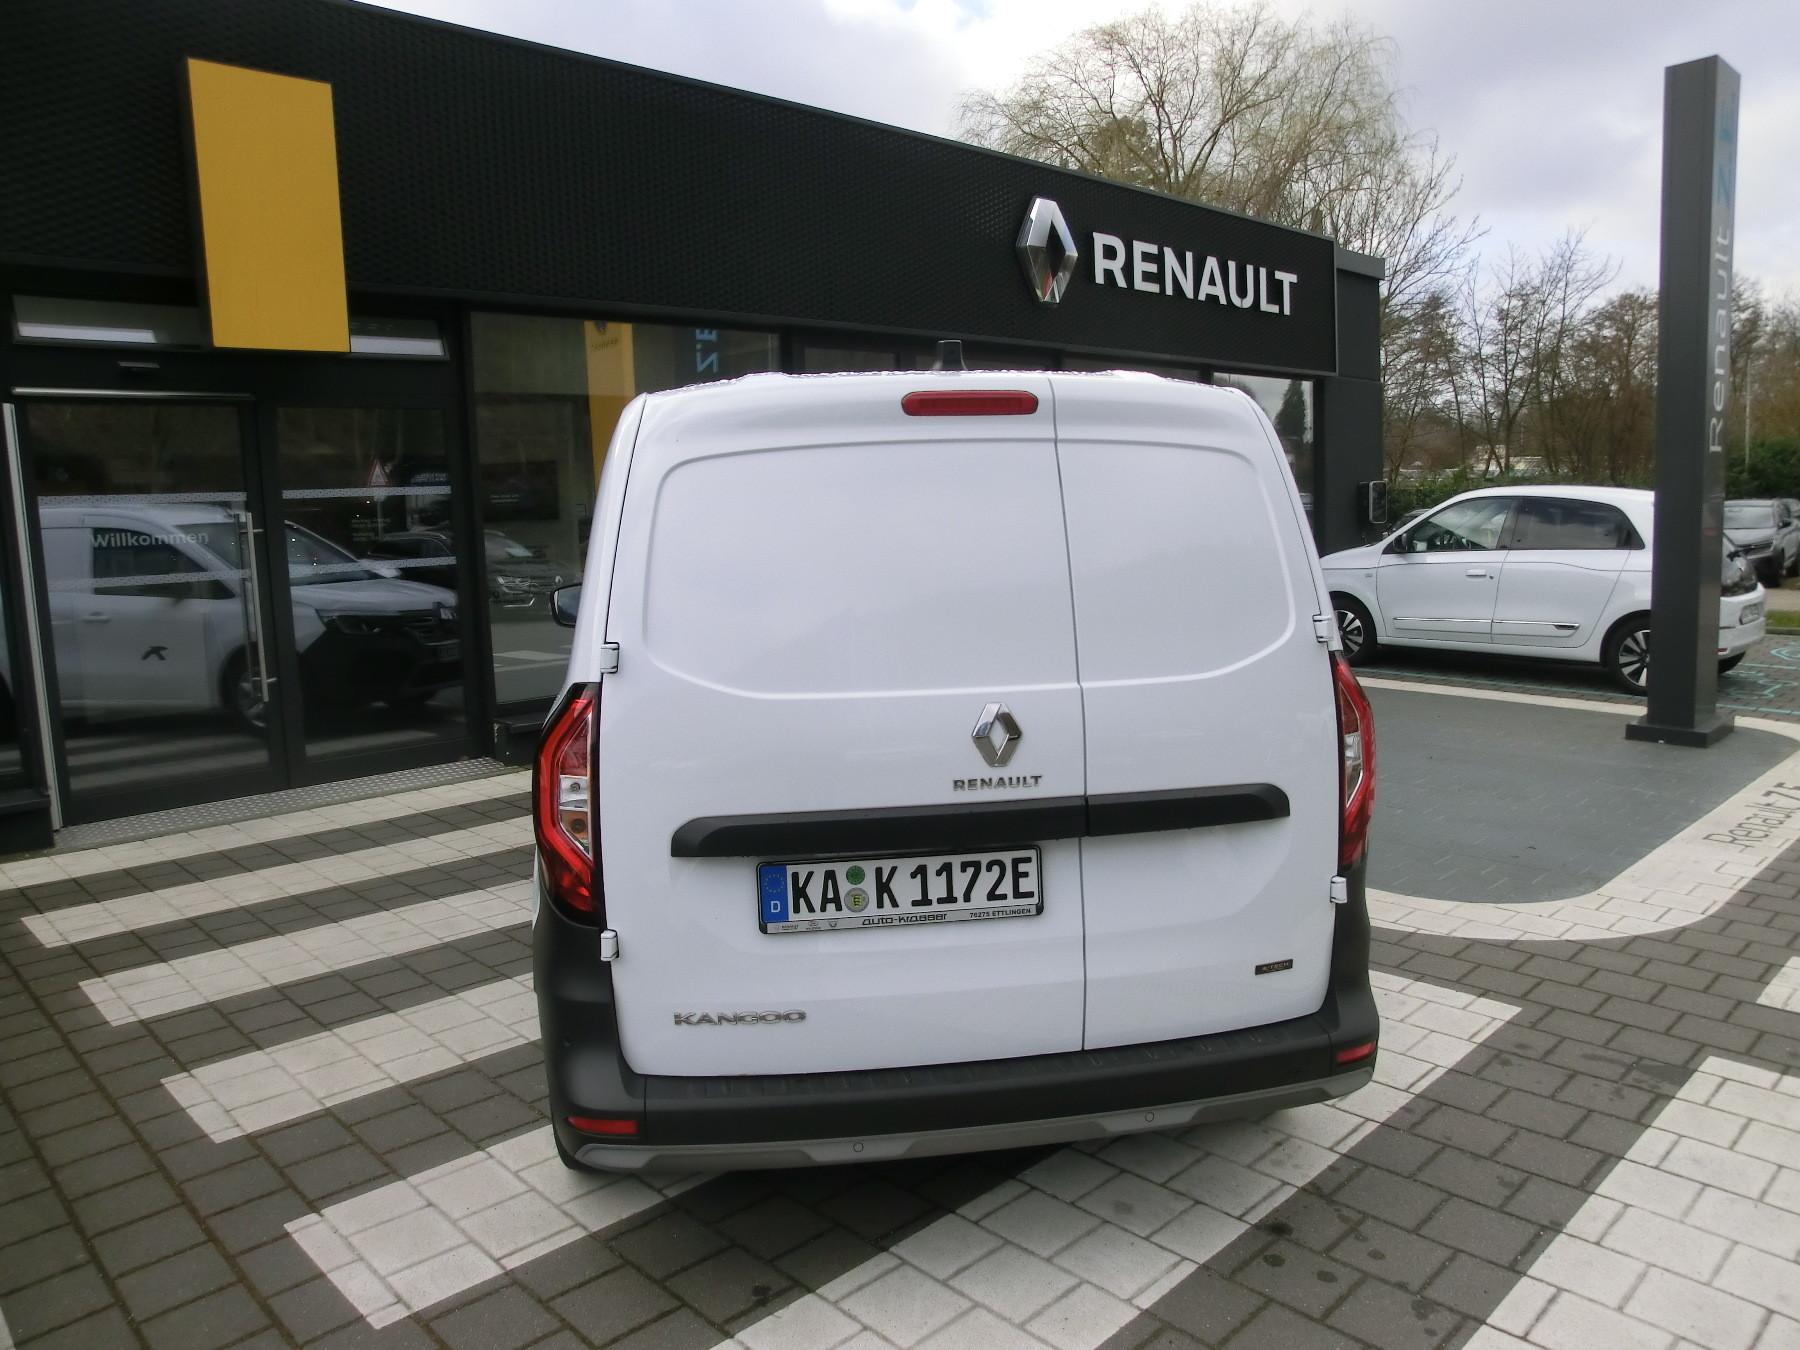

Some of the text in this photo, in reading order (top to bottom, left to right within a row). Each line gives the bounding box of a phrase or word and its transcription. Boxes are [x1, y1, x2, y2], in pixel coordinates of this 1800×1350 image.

[1092, 231, 1298, 316] RENAULT
[1709, 226, 1731, 453] Renault
[91, 532, 208, 548] Willkommen
[952, 775, 1042, 791] RENAULT
[1702, 801, 1800, 849] Renault
[791, 868, 843, 914] KA
[770, 900, 781, 913] D
[992, 907, 1031, 917] ETTLINGEN
[673, 1010, 806, 1025] KANGOO
